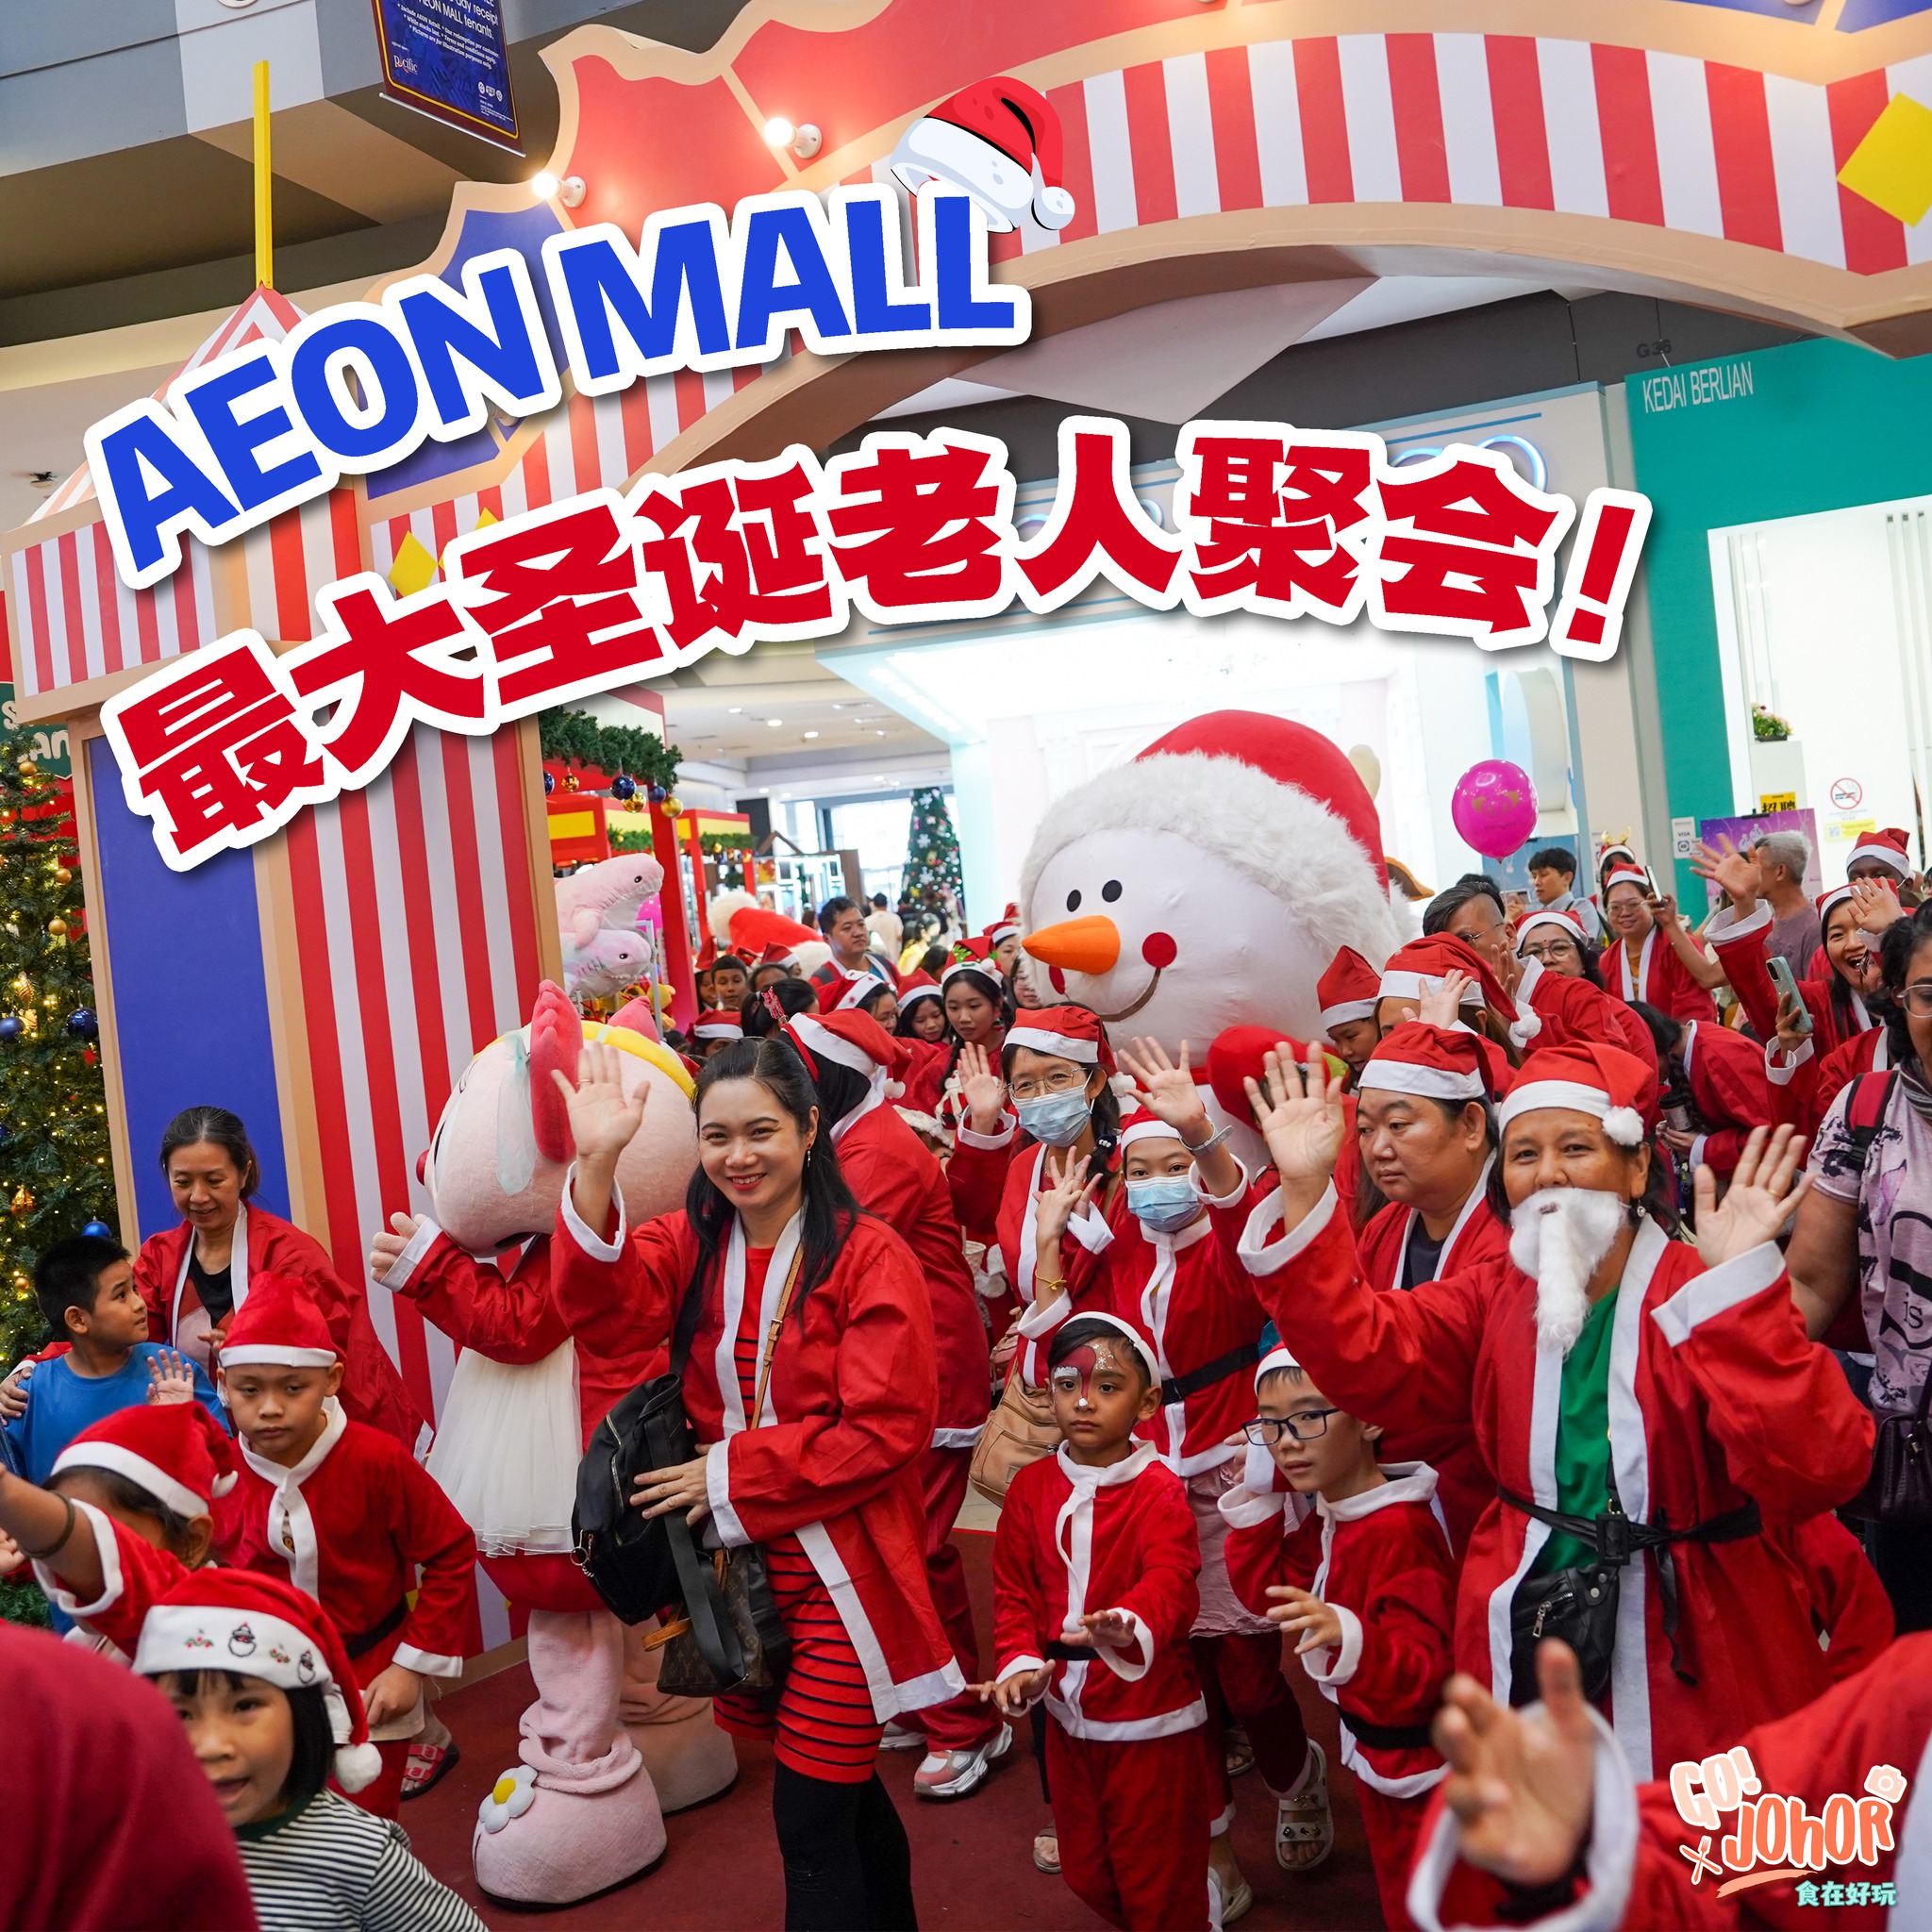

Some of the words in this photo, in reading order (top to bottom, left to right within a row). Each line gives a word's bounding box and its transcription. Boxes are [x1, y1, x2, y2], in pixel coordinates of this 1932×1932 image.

[418, 0, 441, 13] EON
[442, 3, 463, 25] MALL
[464, 14, 494, 40] tenants.
[473, 4, 498, 26] receipt
[1642, 374, 1687, 414] KEDAI
[1690, 361, 1754, 406] BERLIAN
[1903, 1291, 1924, 1329] is
